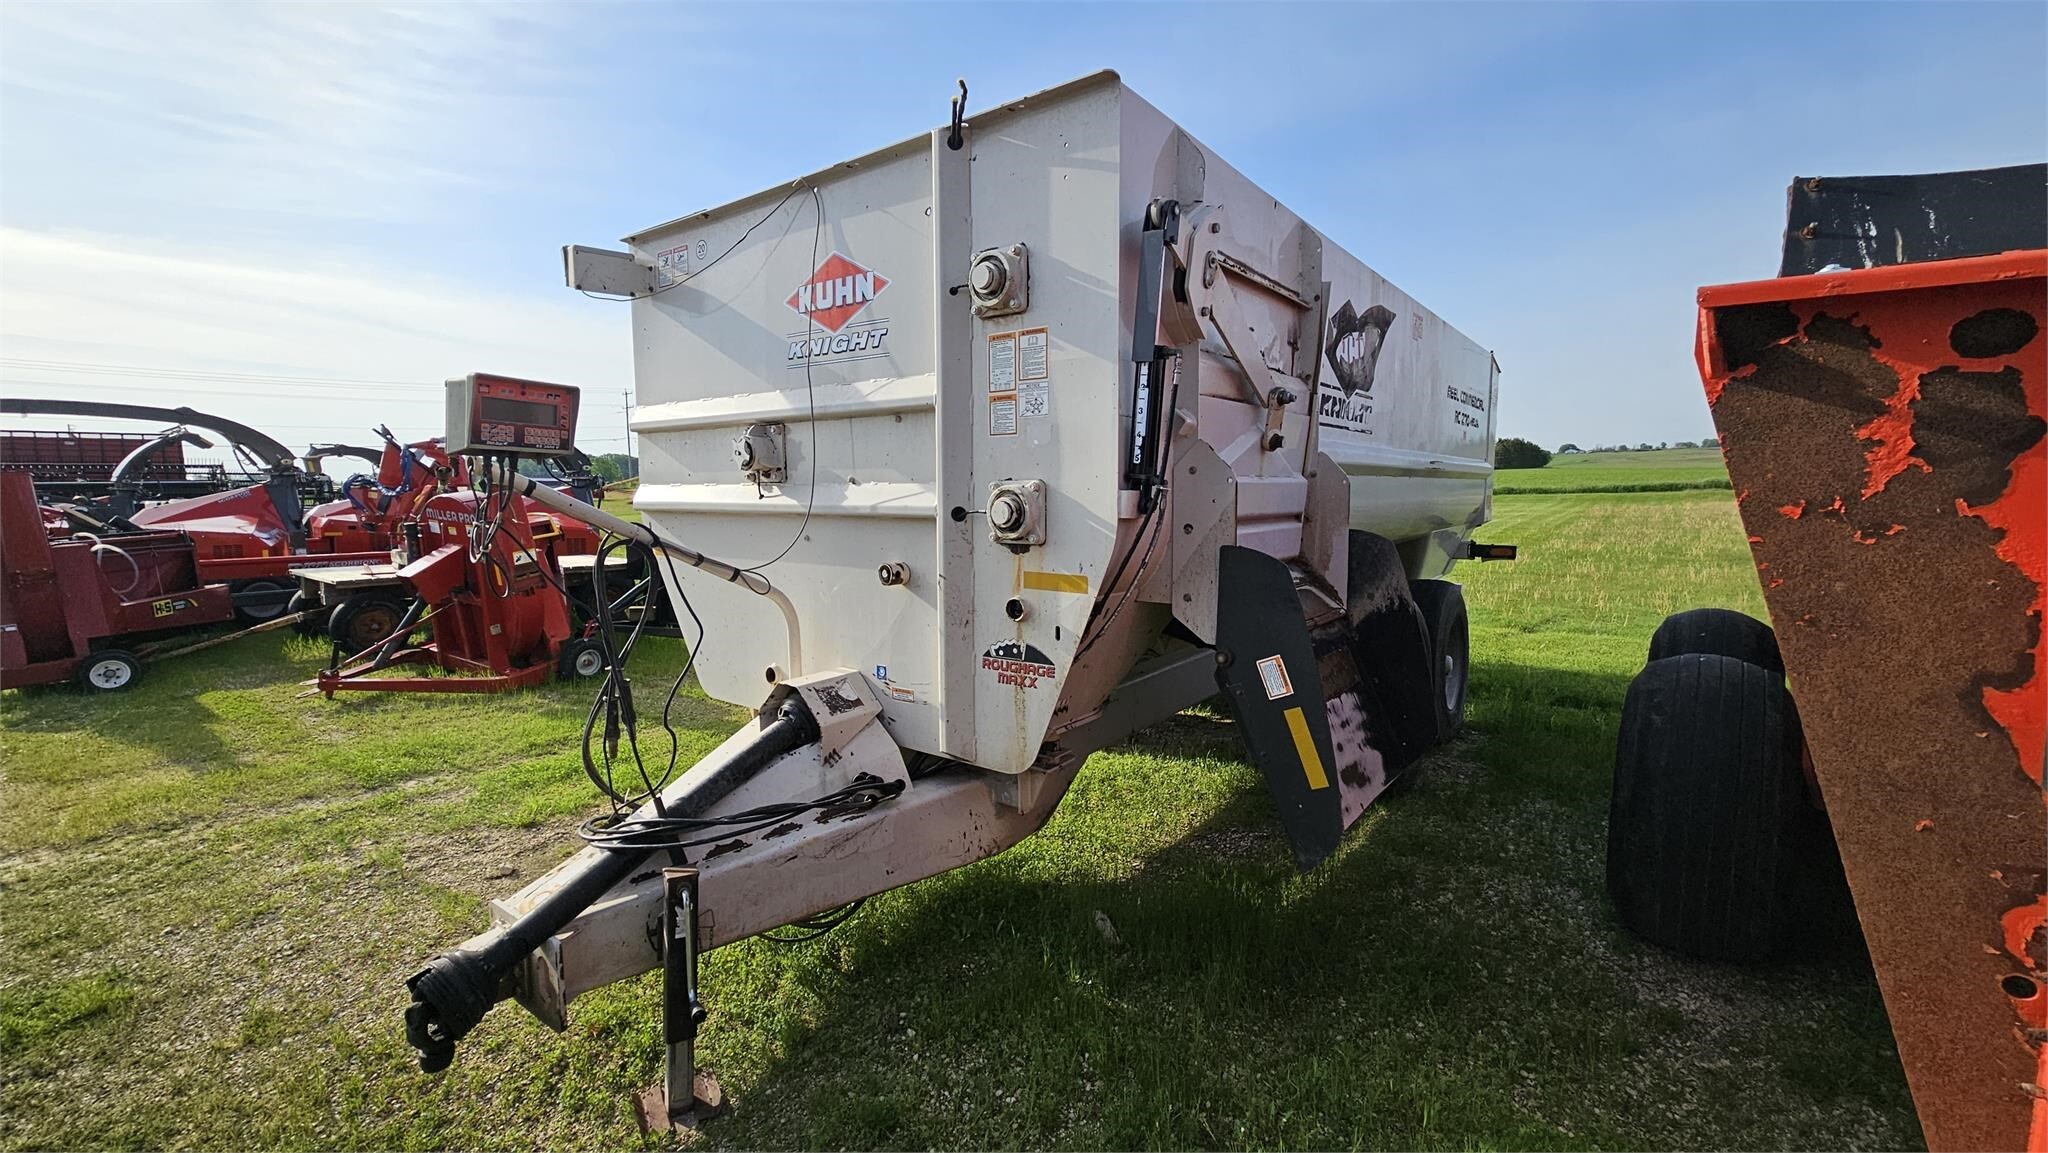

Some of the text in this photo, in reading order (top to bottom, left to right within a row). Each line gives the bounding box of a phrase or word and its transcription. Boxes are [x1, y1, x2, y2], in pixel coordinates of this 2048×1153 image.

[798, 270, 875, 314] KUHN
[788, 328, 888, 360] KNIGHT
[425, 507, 476, 524] MILLER PRO
[982, 657, 1056, 679] ROUGHAGE
[997, 672, 1039, 689] MAXX
